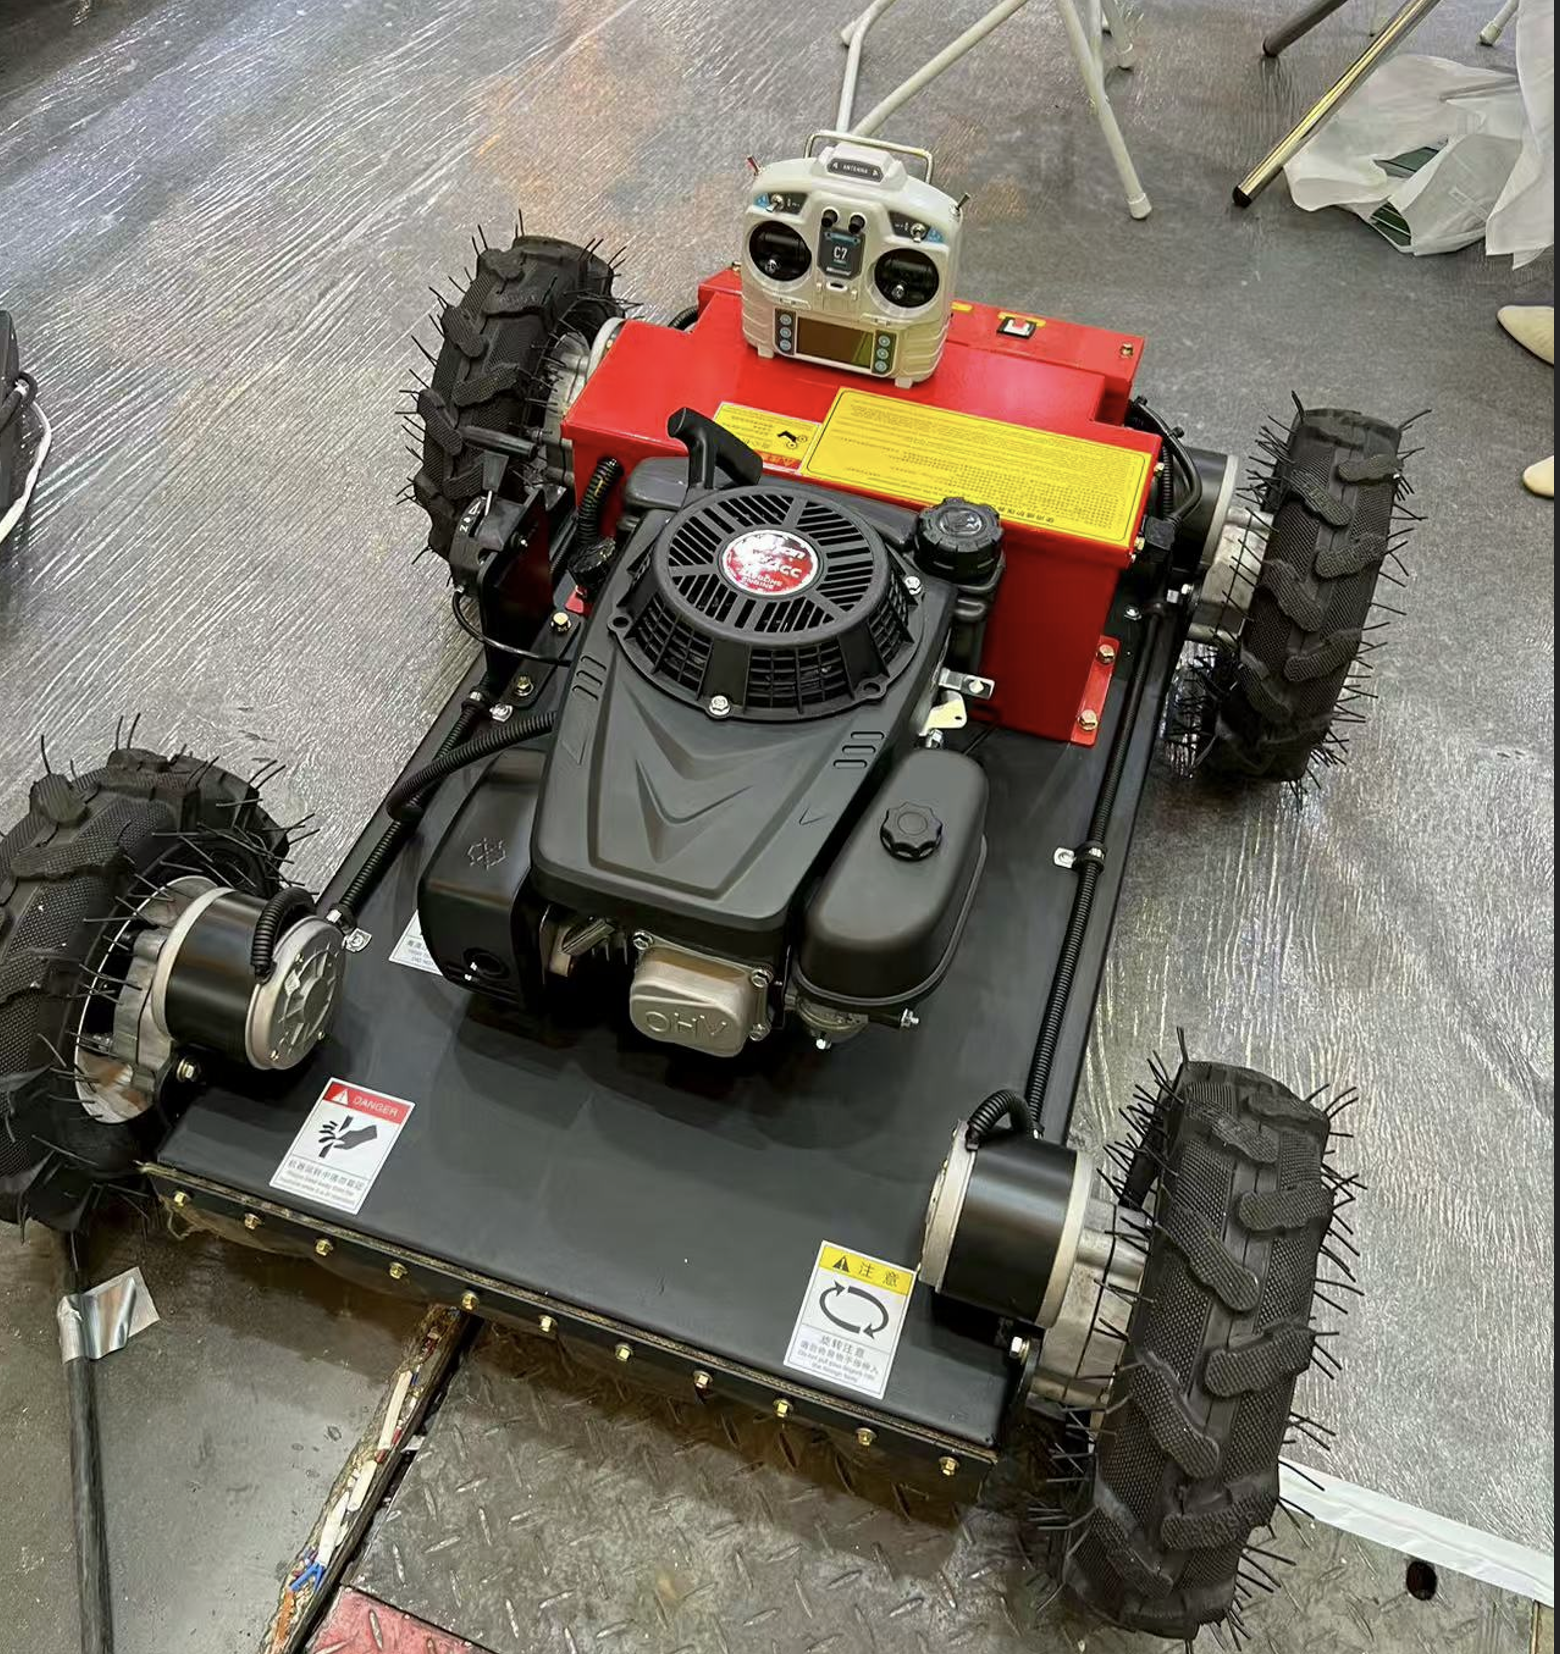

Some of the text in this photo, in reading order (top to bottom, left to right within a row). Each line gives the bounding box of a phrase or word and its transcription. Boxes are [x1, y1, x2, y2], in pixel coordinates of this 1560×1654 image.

[842, 164, 868, 174] ANTENNA
[833, 245, 848, 260] C7
[645, 1011, 727, 1038] OHV
[353, 1095, 399, 1117] DANGER
[858, 1261, 898, 1287] 注意
